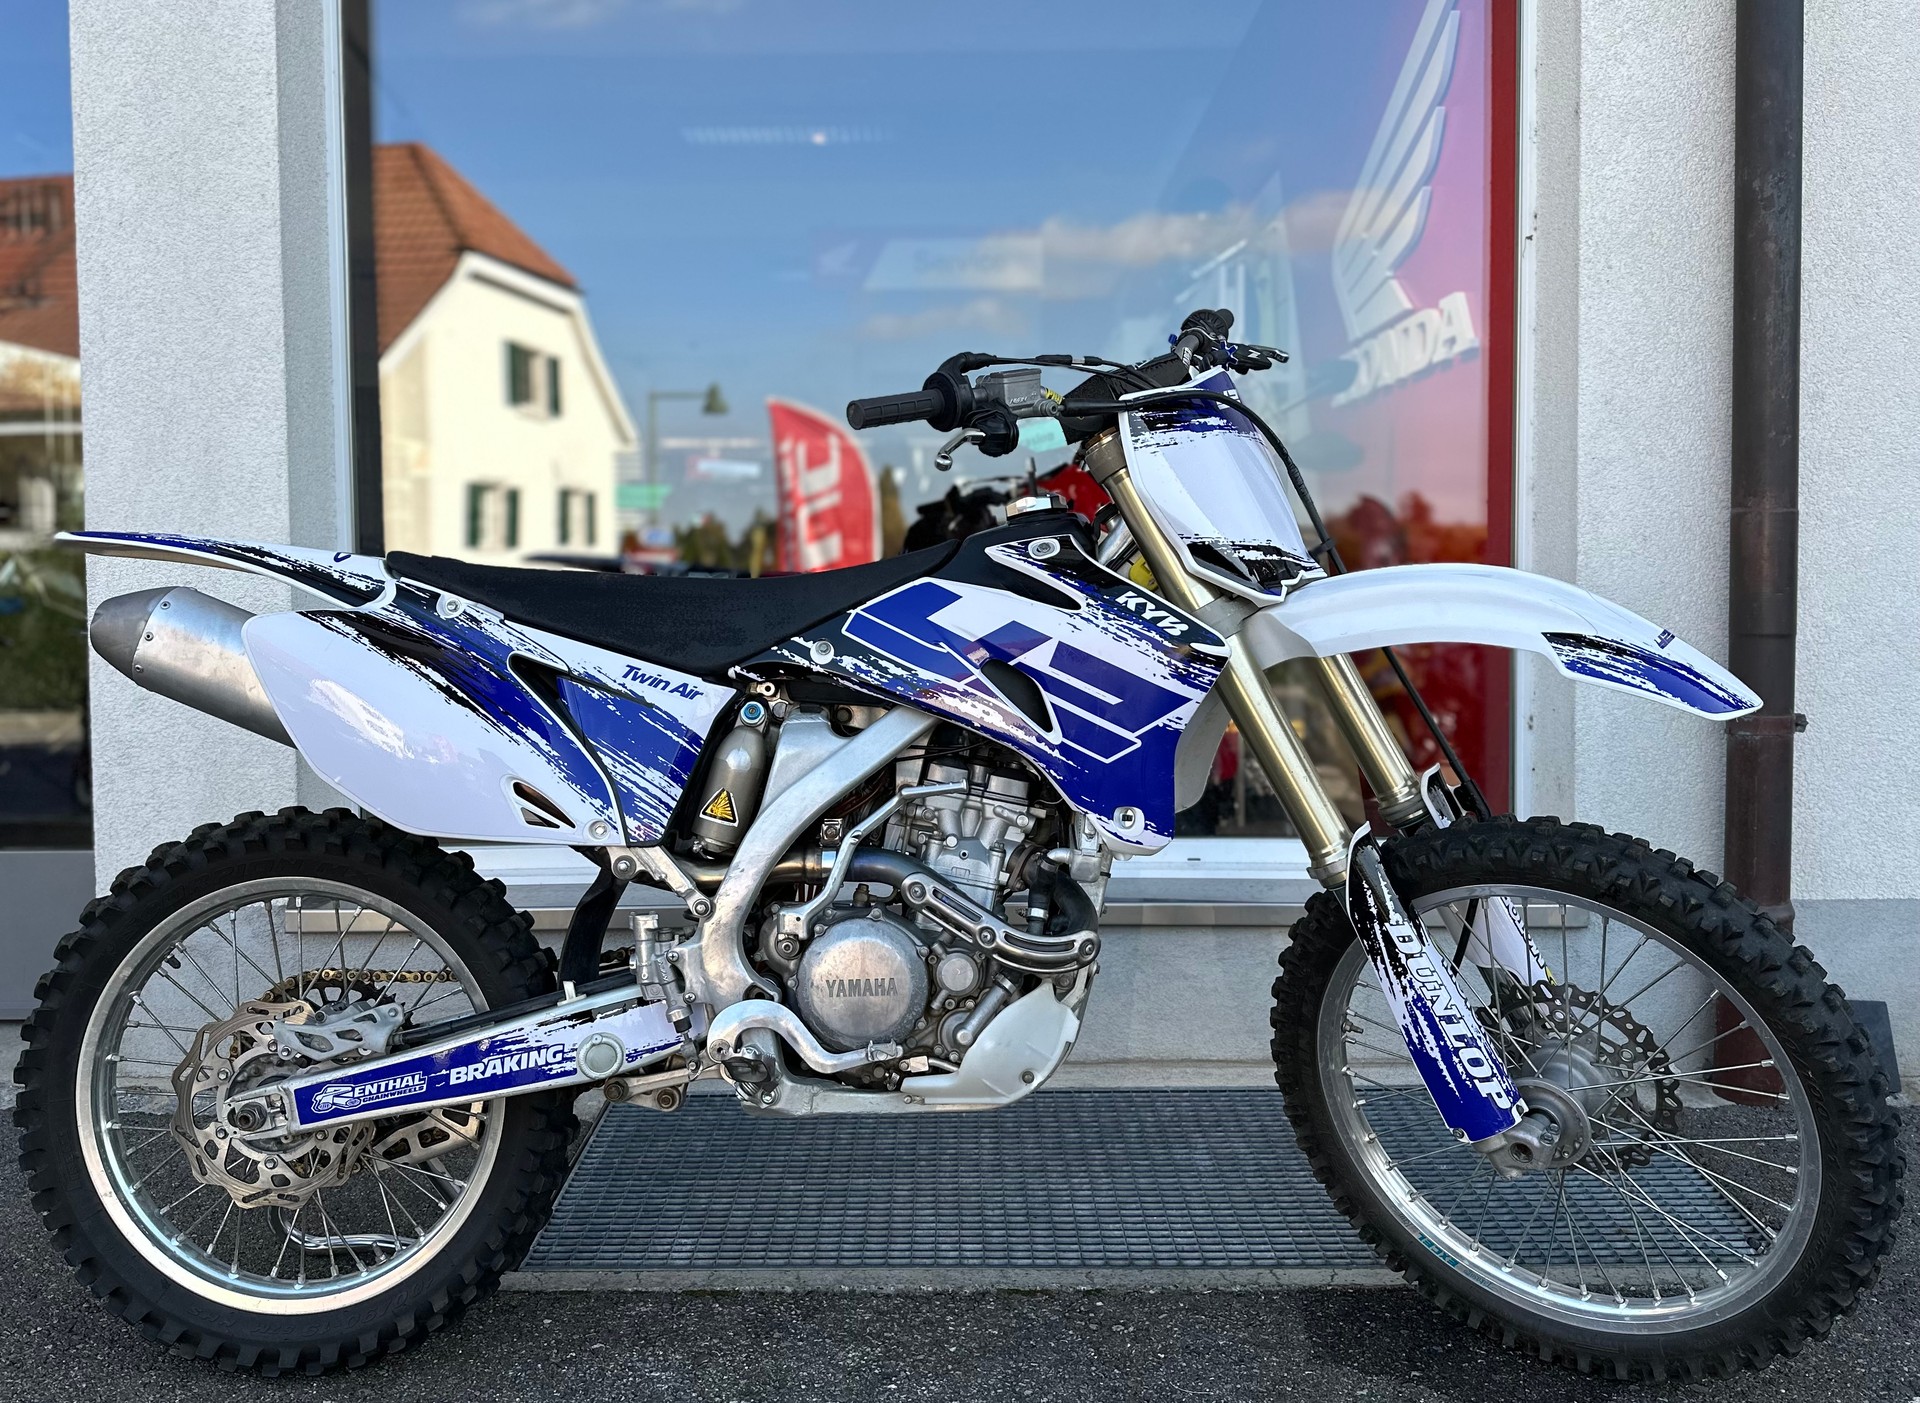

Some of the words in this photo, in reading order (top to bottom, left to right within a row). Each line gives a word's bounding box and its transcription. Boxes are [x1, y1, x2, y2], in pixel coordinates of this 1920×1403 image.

[1115, 590, 1190, 636] KYB
[621, 663, 670, 690] Twin
[668, 681, 704, 701] Air
[825, 977, 898, 998] YAMAHA
[1385, 921, 1513, 1110] DUNLOP
[449, 1043, 565, 1087] BRAKING
[361, 1085, 426, 1103] CHAINWHEELS
[1417, 1232, 1459, 1269] EXCEL
